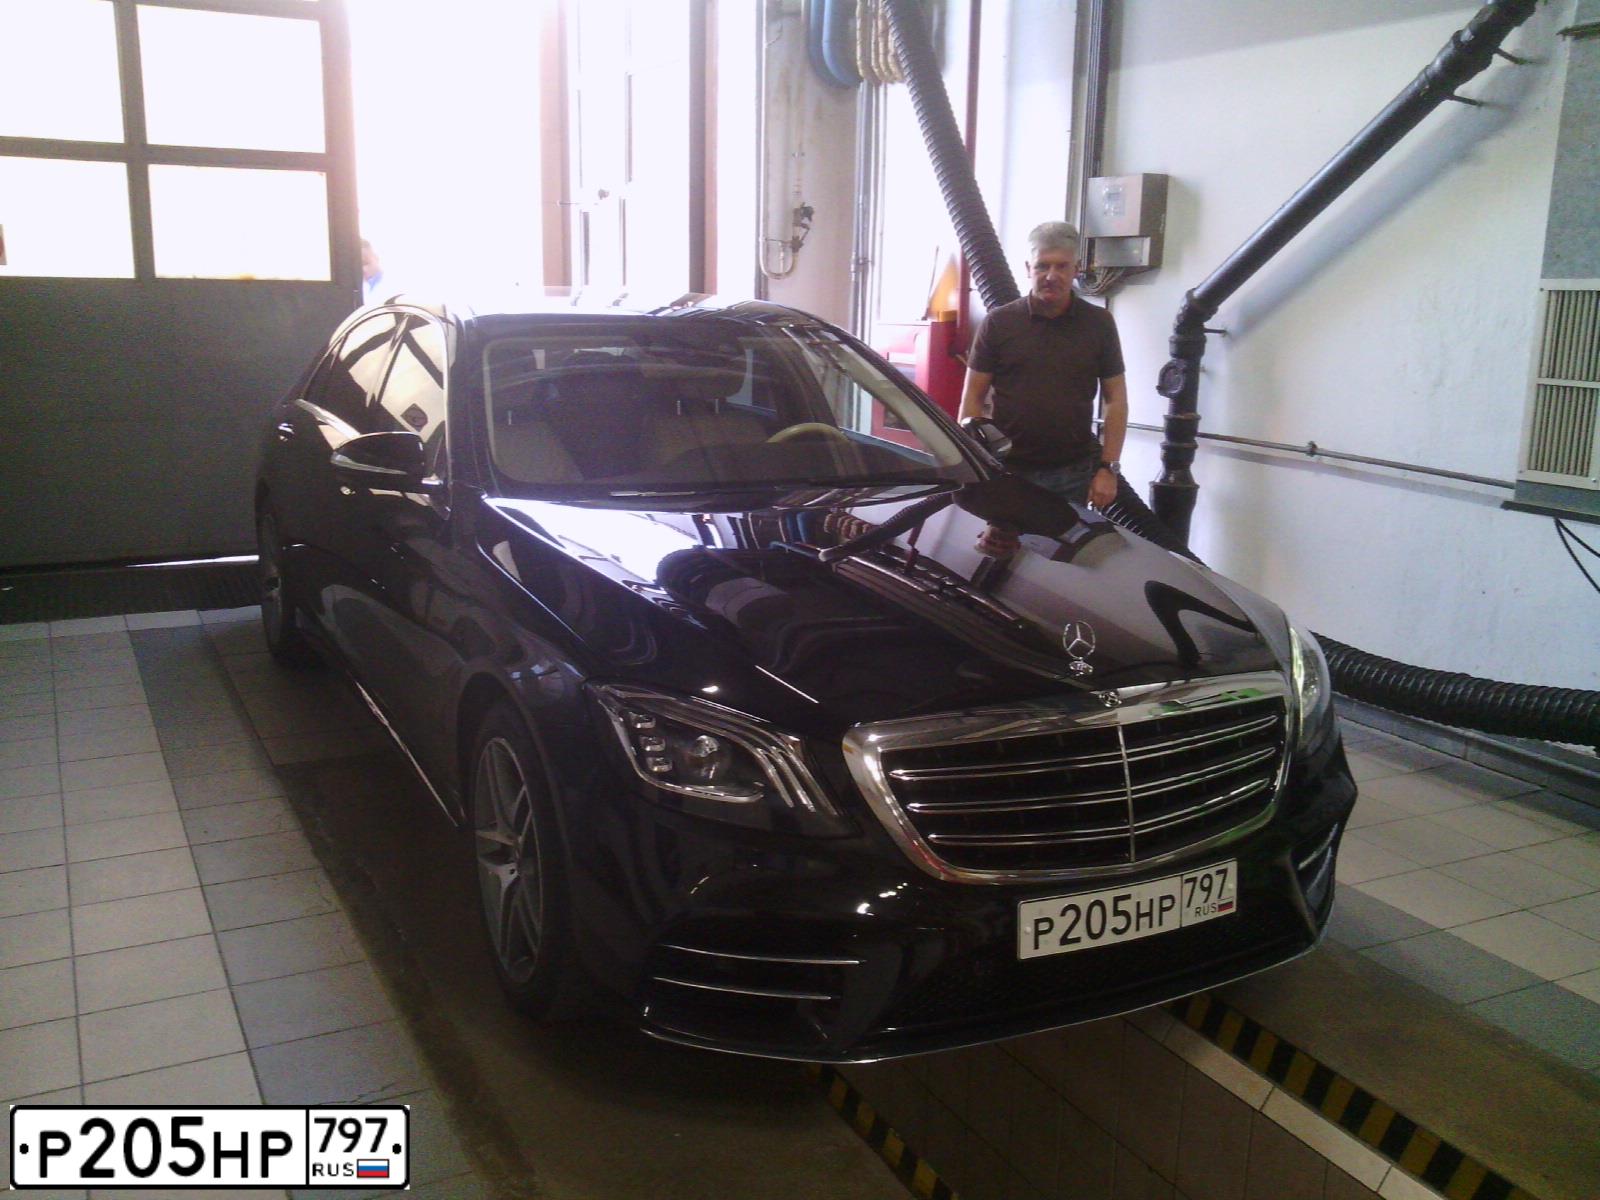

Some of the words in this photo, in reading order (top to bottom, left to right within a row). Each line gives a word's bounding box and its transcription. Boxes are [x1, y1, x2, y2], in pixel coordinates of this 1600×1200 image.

[1033, 894, 1176, 950] P205HP
[1184, 868, 1229, 908] 797
[1194, 902, 1218, 918] RUS
